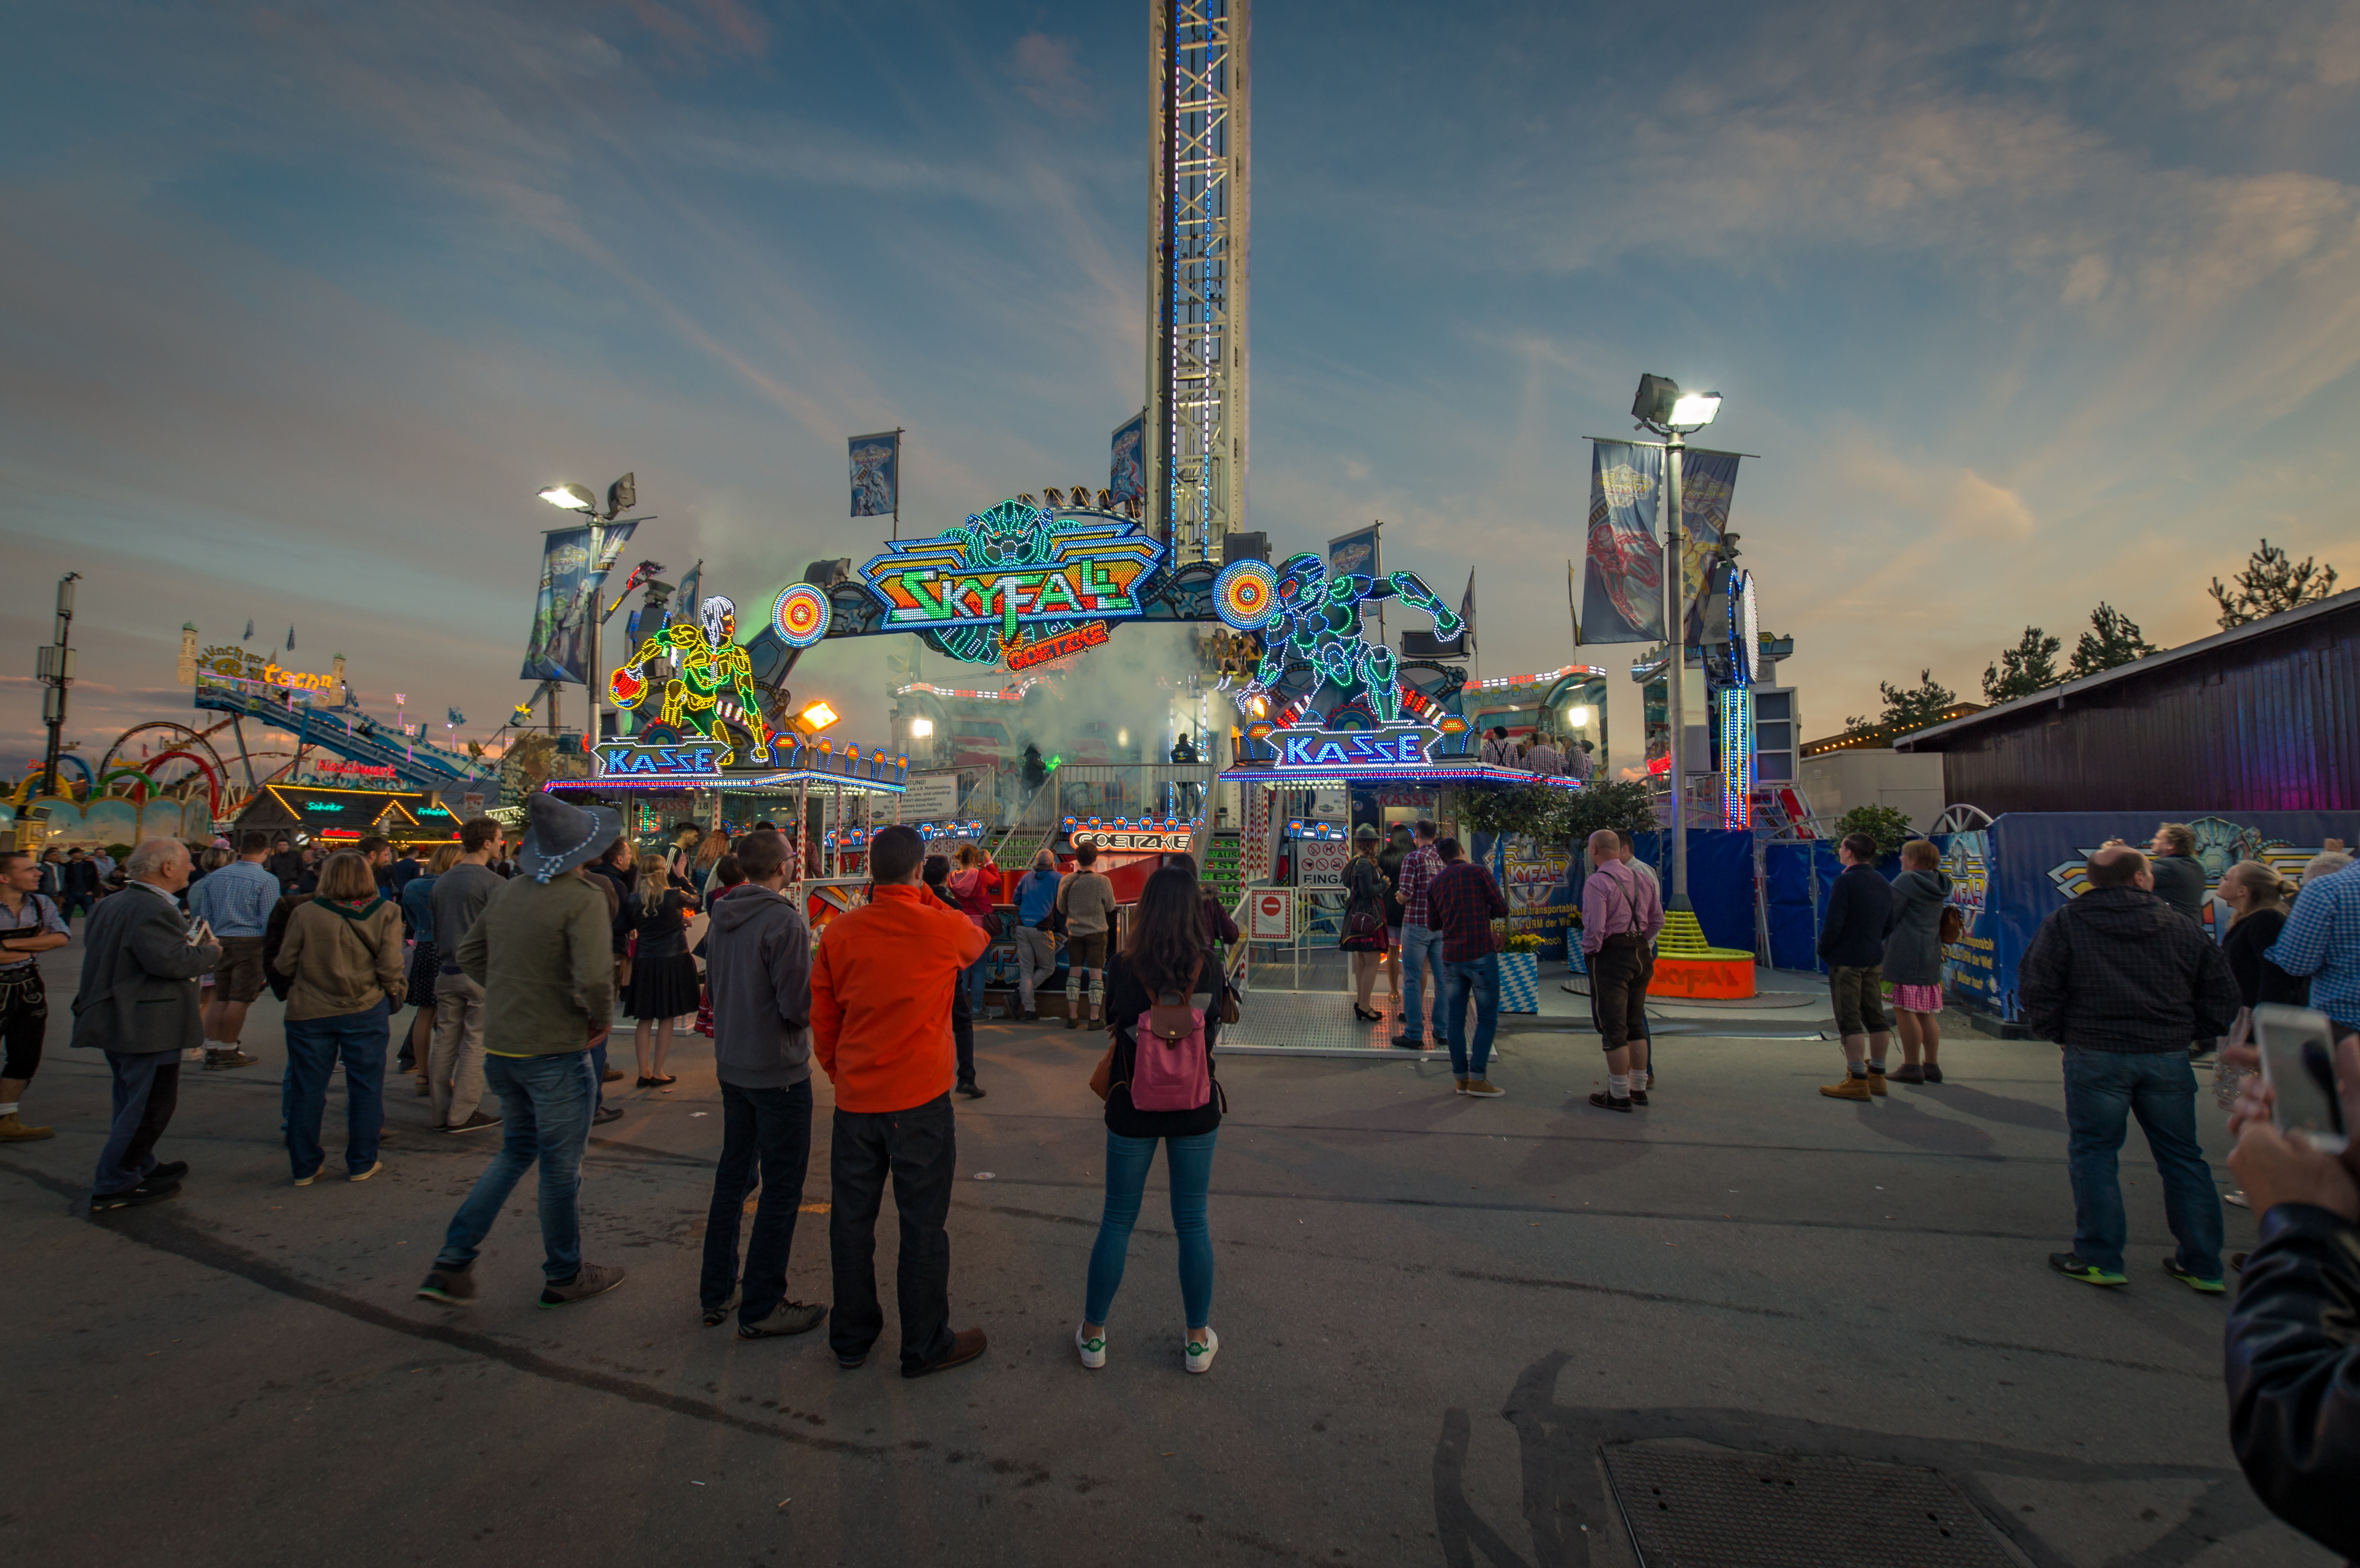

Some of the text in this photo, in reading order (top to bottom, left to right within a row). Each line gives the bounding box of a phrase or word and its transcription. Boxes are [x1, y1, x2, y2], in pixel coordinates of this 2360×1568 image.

[890, 559, 1132, 643] SKYFALL
[1008, 623, 1107, 670] GOETZKE
[1286, 734, 1423, 764] KASSE
[316, 759, 396, 777] Naschwerk
[608, 748, 715, 773] KASSE
[307, 801, 344, 811] Schoko
[650, 800, 692, 811] KASSE
[697, 802, 709, 810] 18
[1377, 794, 1432, 806] KASSE
[1072, 831, 1191, 850] GOETZKE
[1529, 903, 1578, 916] transportable
[1545, 918, 1557, 928] der
